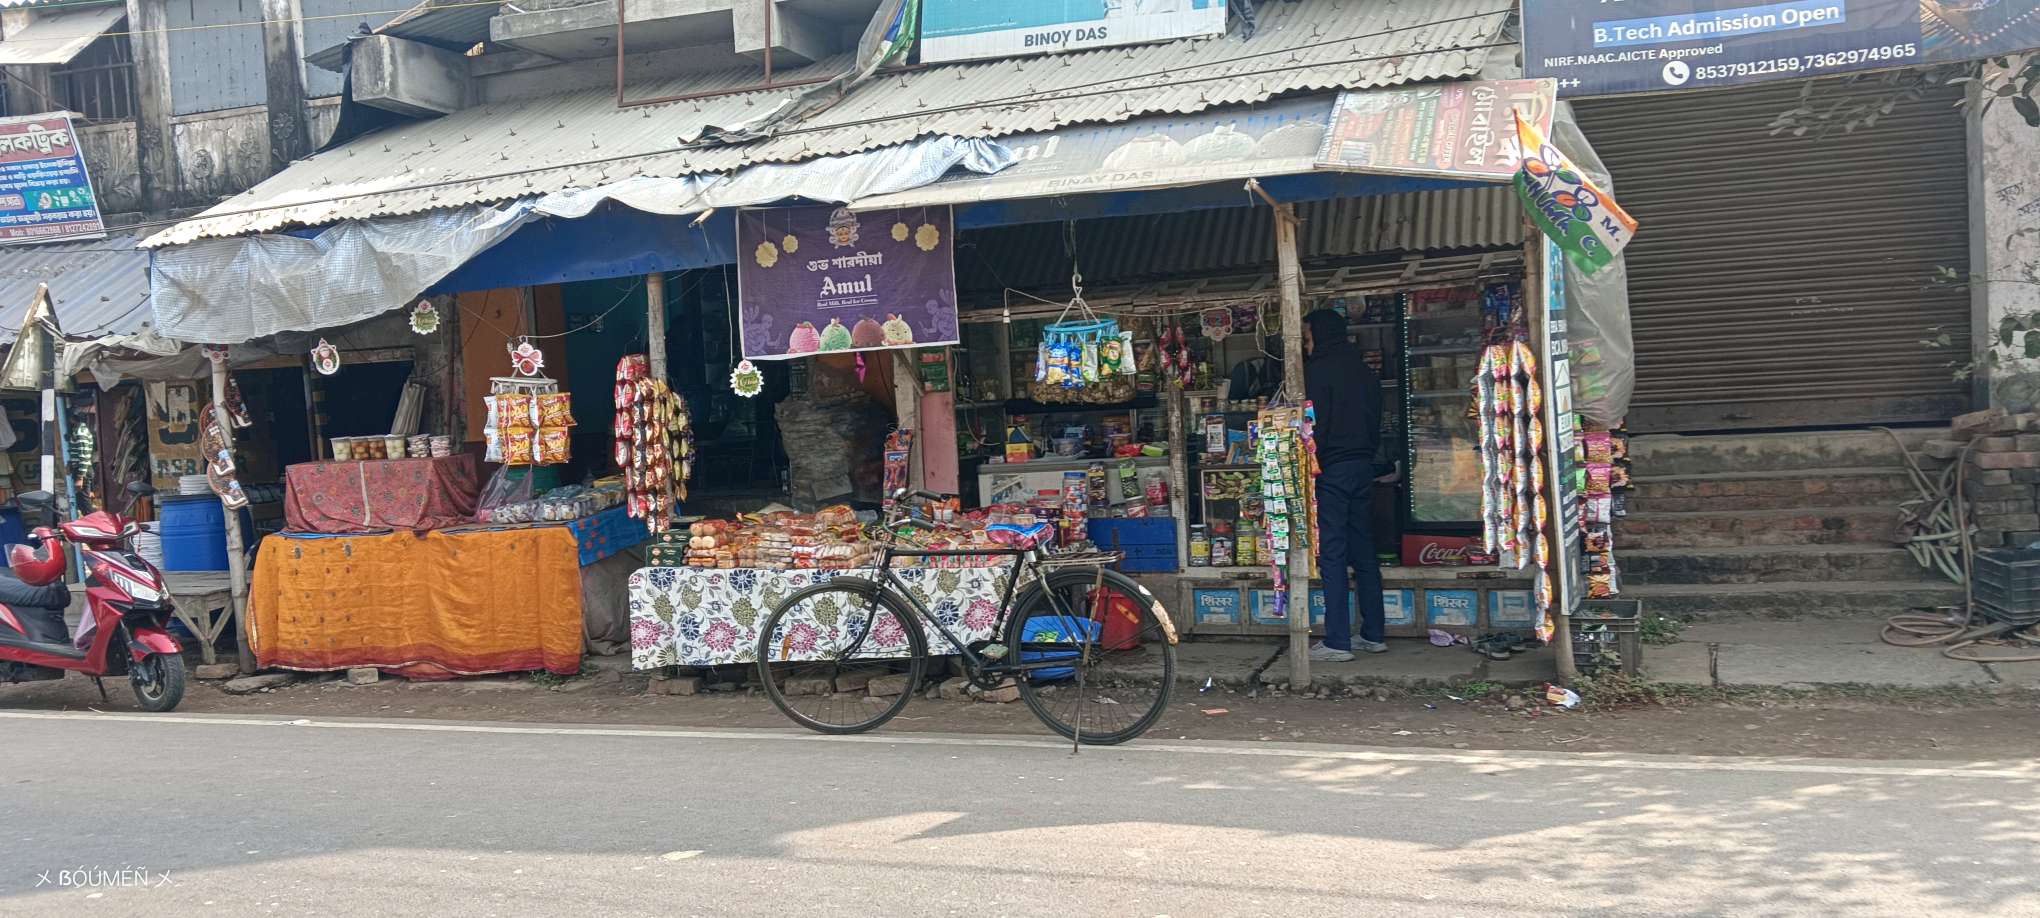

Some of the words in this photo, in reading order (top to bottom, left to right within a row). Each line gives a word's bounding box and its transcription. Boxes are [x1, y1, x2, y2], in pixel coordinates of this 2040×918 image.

[1024, 29, 1072, 47] BINOY
[1075, 26, 1108, 42] DAS
[1594, 22, 1662, 43] B.Tech
[1668, 12, 1776, 37] Admission
[1782, 6, 1839, 27] Open
[1544, 49, 1656, 68] NIRF.NAAC.AICTE
[1659, 43, 1723, 61] Approved
[1696, 43, 1916, 80] 8537912159,7362974965
[1463, 86, 1498, 166] মোবাইল
[1047, 173, 1108, 188] BINAY
[1110, 171, 1154, 182] DAS
[806, 258, 829, 272] শুভ
[832, 251, 883, 269] শারদীয়া
[820, 274, 872, 298] Amul
